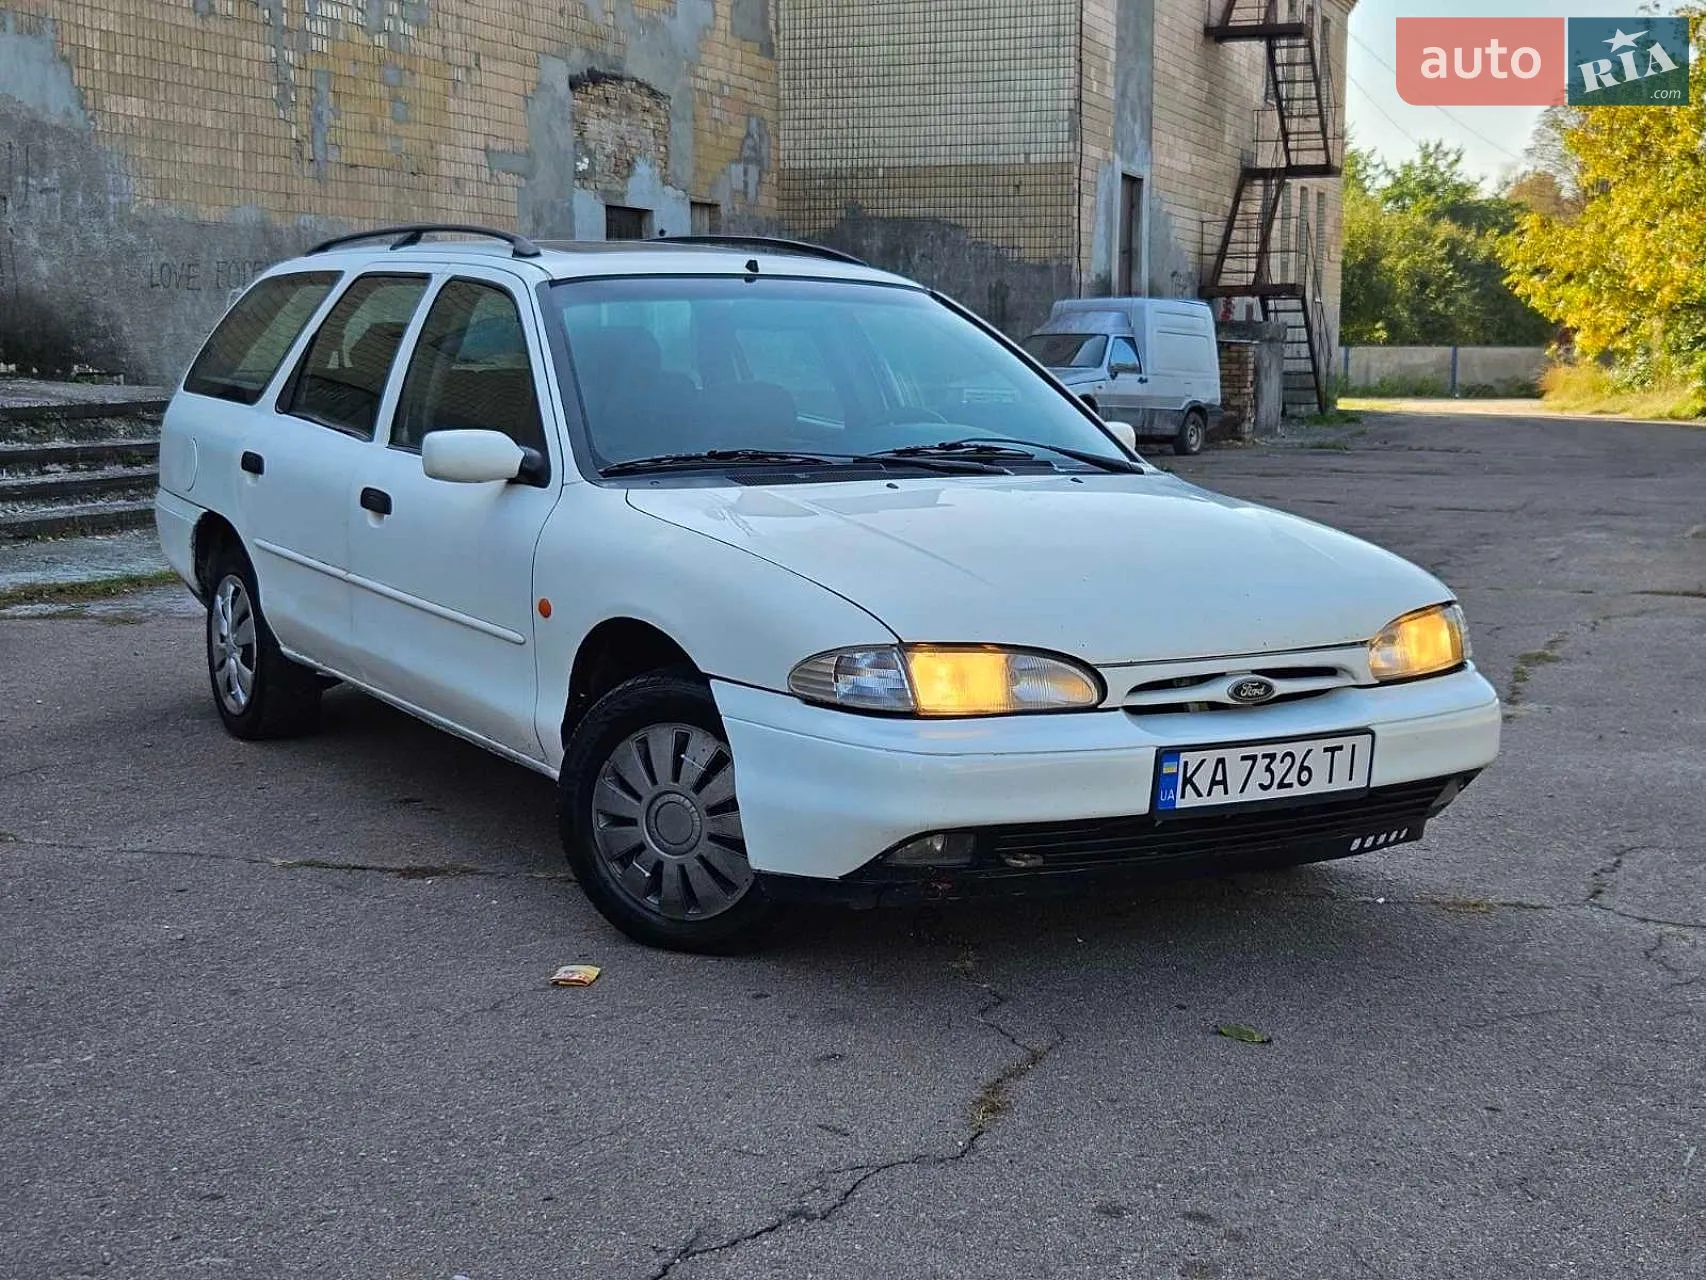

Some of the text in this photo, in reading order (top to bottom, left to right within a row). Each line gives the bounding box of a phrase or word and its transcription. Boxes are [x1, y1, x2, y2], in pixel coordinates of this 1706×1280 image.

[149, 261, 201, 290] LOVE
[1240, 681, 1266, 697] Ford
[1180, 743, 1357, 800] KA 7326 TI
[1160, 788, 1175, 801] UA
